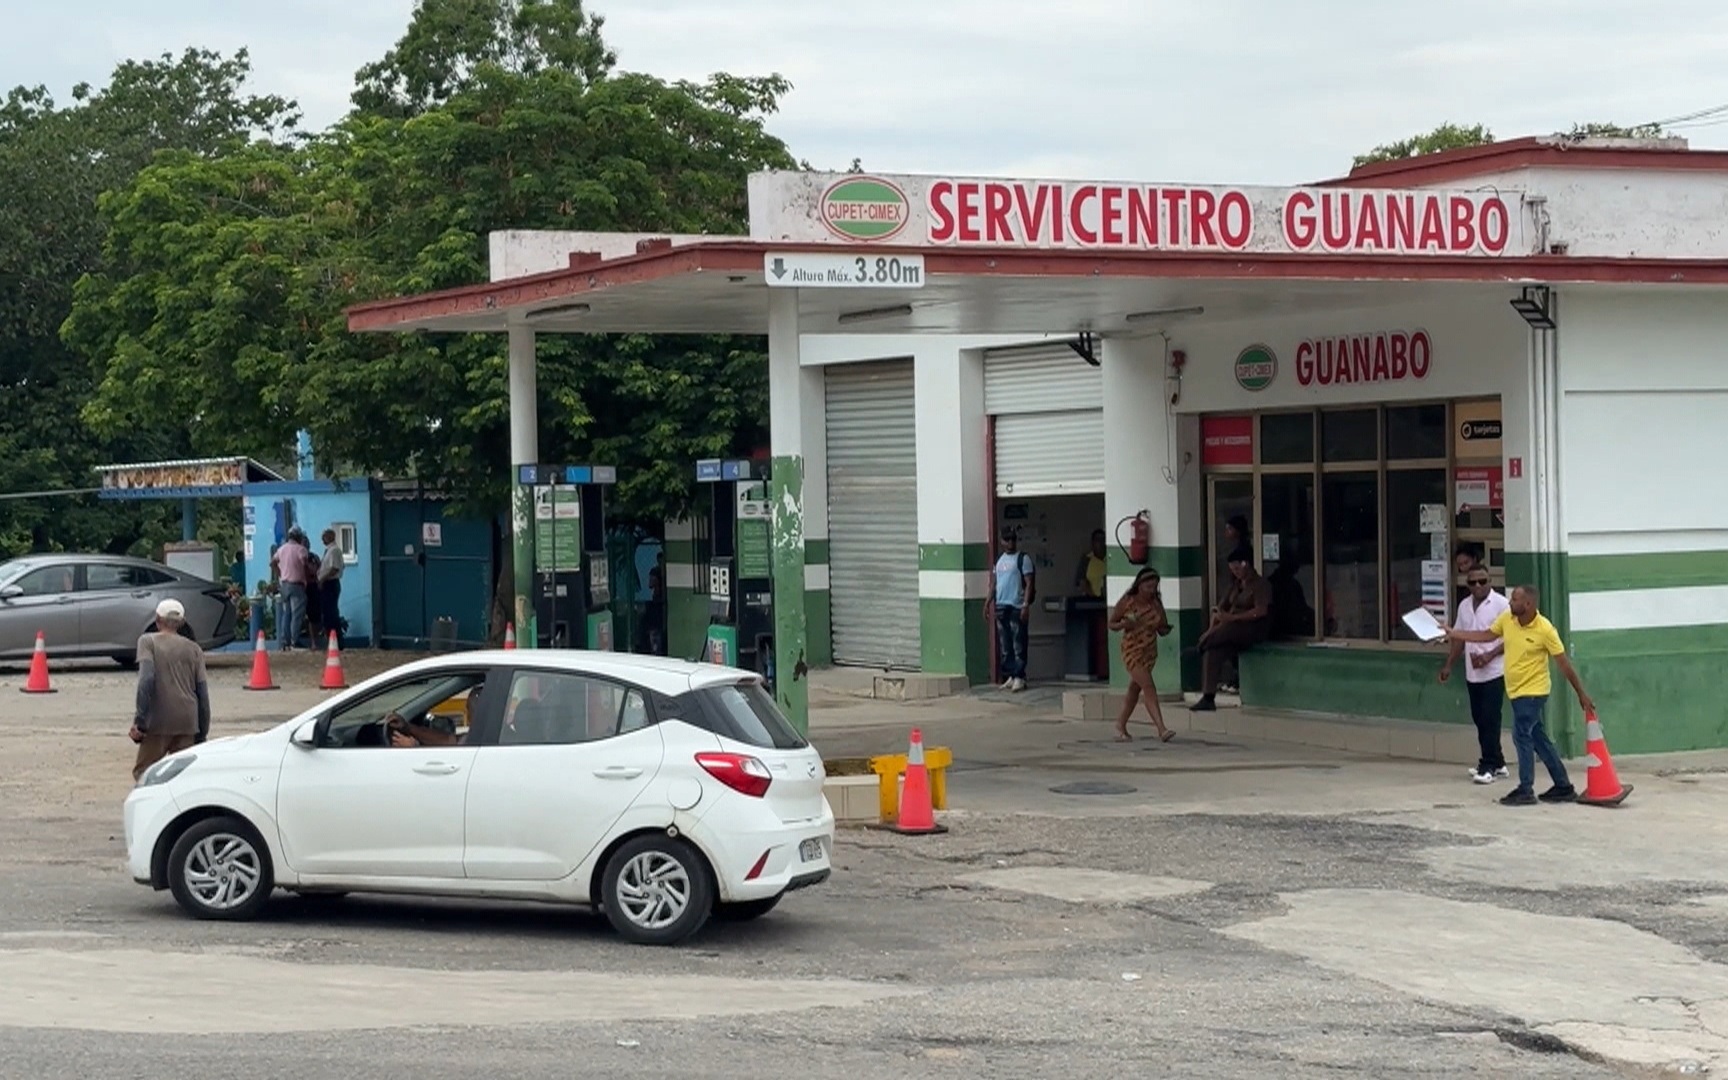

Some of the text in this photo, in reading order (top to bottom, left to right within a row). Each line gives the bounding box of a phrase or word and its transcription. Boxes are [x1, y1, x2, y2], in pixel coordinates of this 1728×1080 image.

[930, 183, 1508, 253] SERVICENTRO GUANABO
[793, 257, 920, 283] Altura Máx. 3.80m
[1296, 331, 1430, 385] GUANABO
[732, 465, 738, 475] 4
